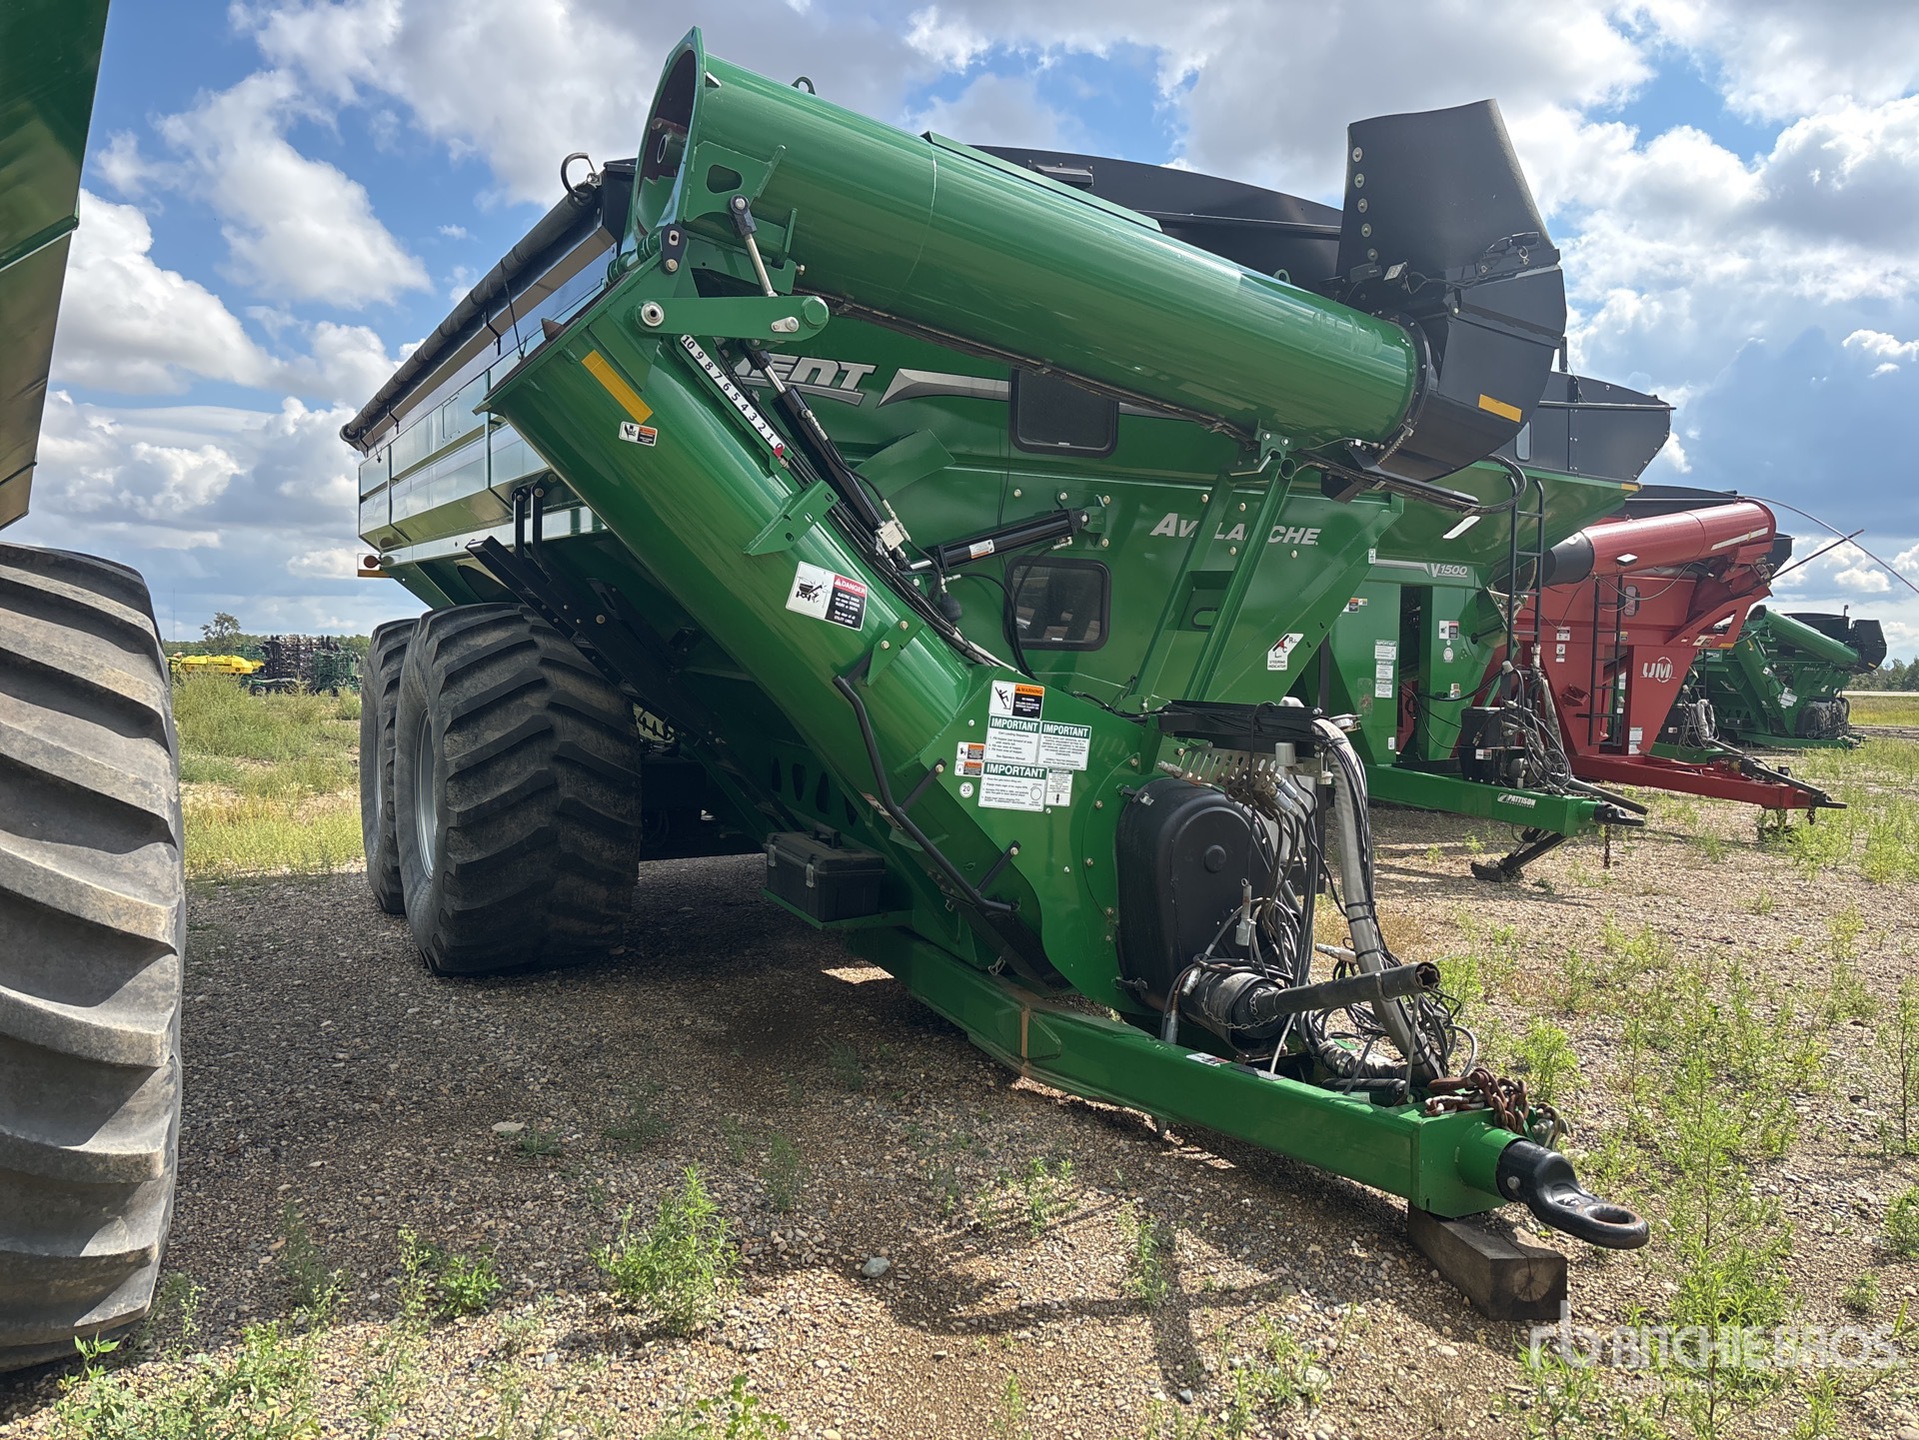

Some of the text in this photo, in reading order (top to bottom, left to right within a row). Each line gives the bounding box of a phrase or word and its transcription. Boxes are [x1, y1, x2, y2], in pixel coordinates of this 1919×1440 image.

[682, 336, 696, 350] 10
[695, 351, 705, 360] 9
[704, 361, 714, 371] 8
[714, 371, 723, 380] 7
[722, 382, 732, 391] 6
[731, 392, 741, 402] 5
[740, 403, 749, 411] 4
[748, 412, 758, 421] 3
[757, 422, 767, 432] 2
[766, 433, 775, 442] 1
[1149, 512, 1322, 545] AVLACHE
[1430, 563, 1468, 578] V1500
[841, 580, 866, 594] DANGER
[991, 717, 1039, 732] IMPORTANT
[1043, 723, 1089, 738] IMPORTANT
[986, 763, 1045, 778] IMPORTANT
[1508, 794, 1537, 806] PATTISON
